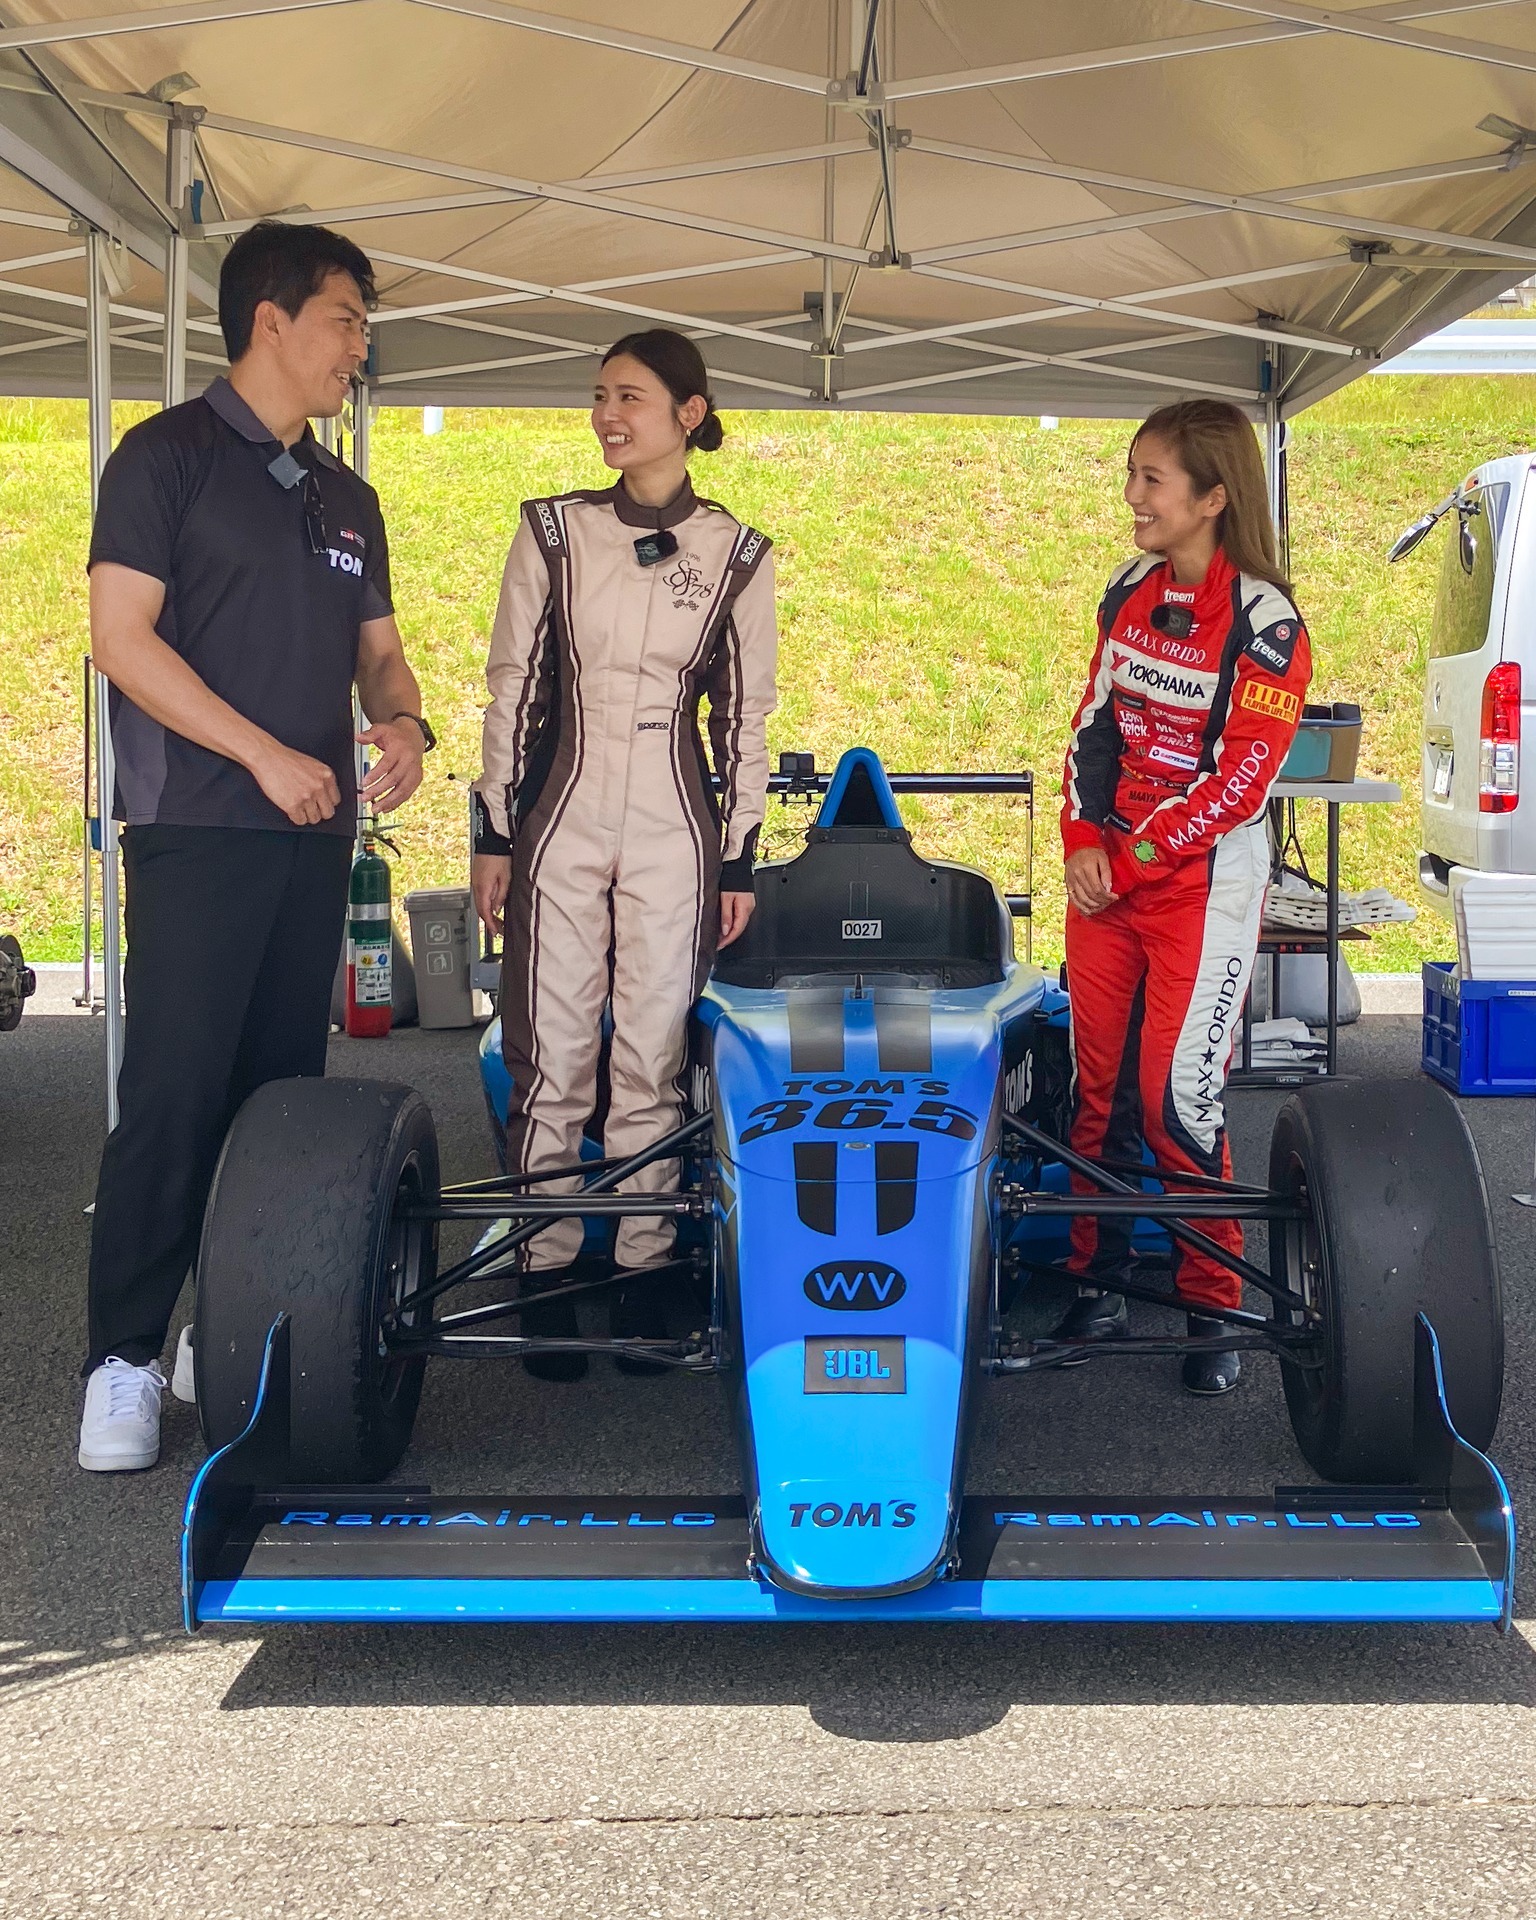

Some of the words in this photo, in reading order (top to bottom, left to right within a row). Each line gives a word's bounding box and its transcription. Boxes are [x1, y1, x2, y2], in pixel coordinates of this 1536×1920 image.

[536, 502, 560, 548] sparco
[740, 530, 765, 566] sparc
[1122, 625, 1158, 652] MAX
[1127, 660, 1206, 699] YOKOHAMA
[1167, 809, 1214, 851] MAX
[1222, 740, 1270, 807] ORIDO
[844, 923, 880, 937] 0027
[1194, 1067, 1214, 1123] MAX
[1207, 956, 1243, 1045] ORIDO
[782, 1078, 951, 1096] TOM'S
[738, 1099, 980, 1145] 36.5
[814, 1271, 897, 1301] WV
[824, 1350, 890, 1379] JBL
[789, 1500, 916, 1528] TOM'S
